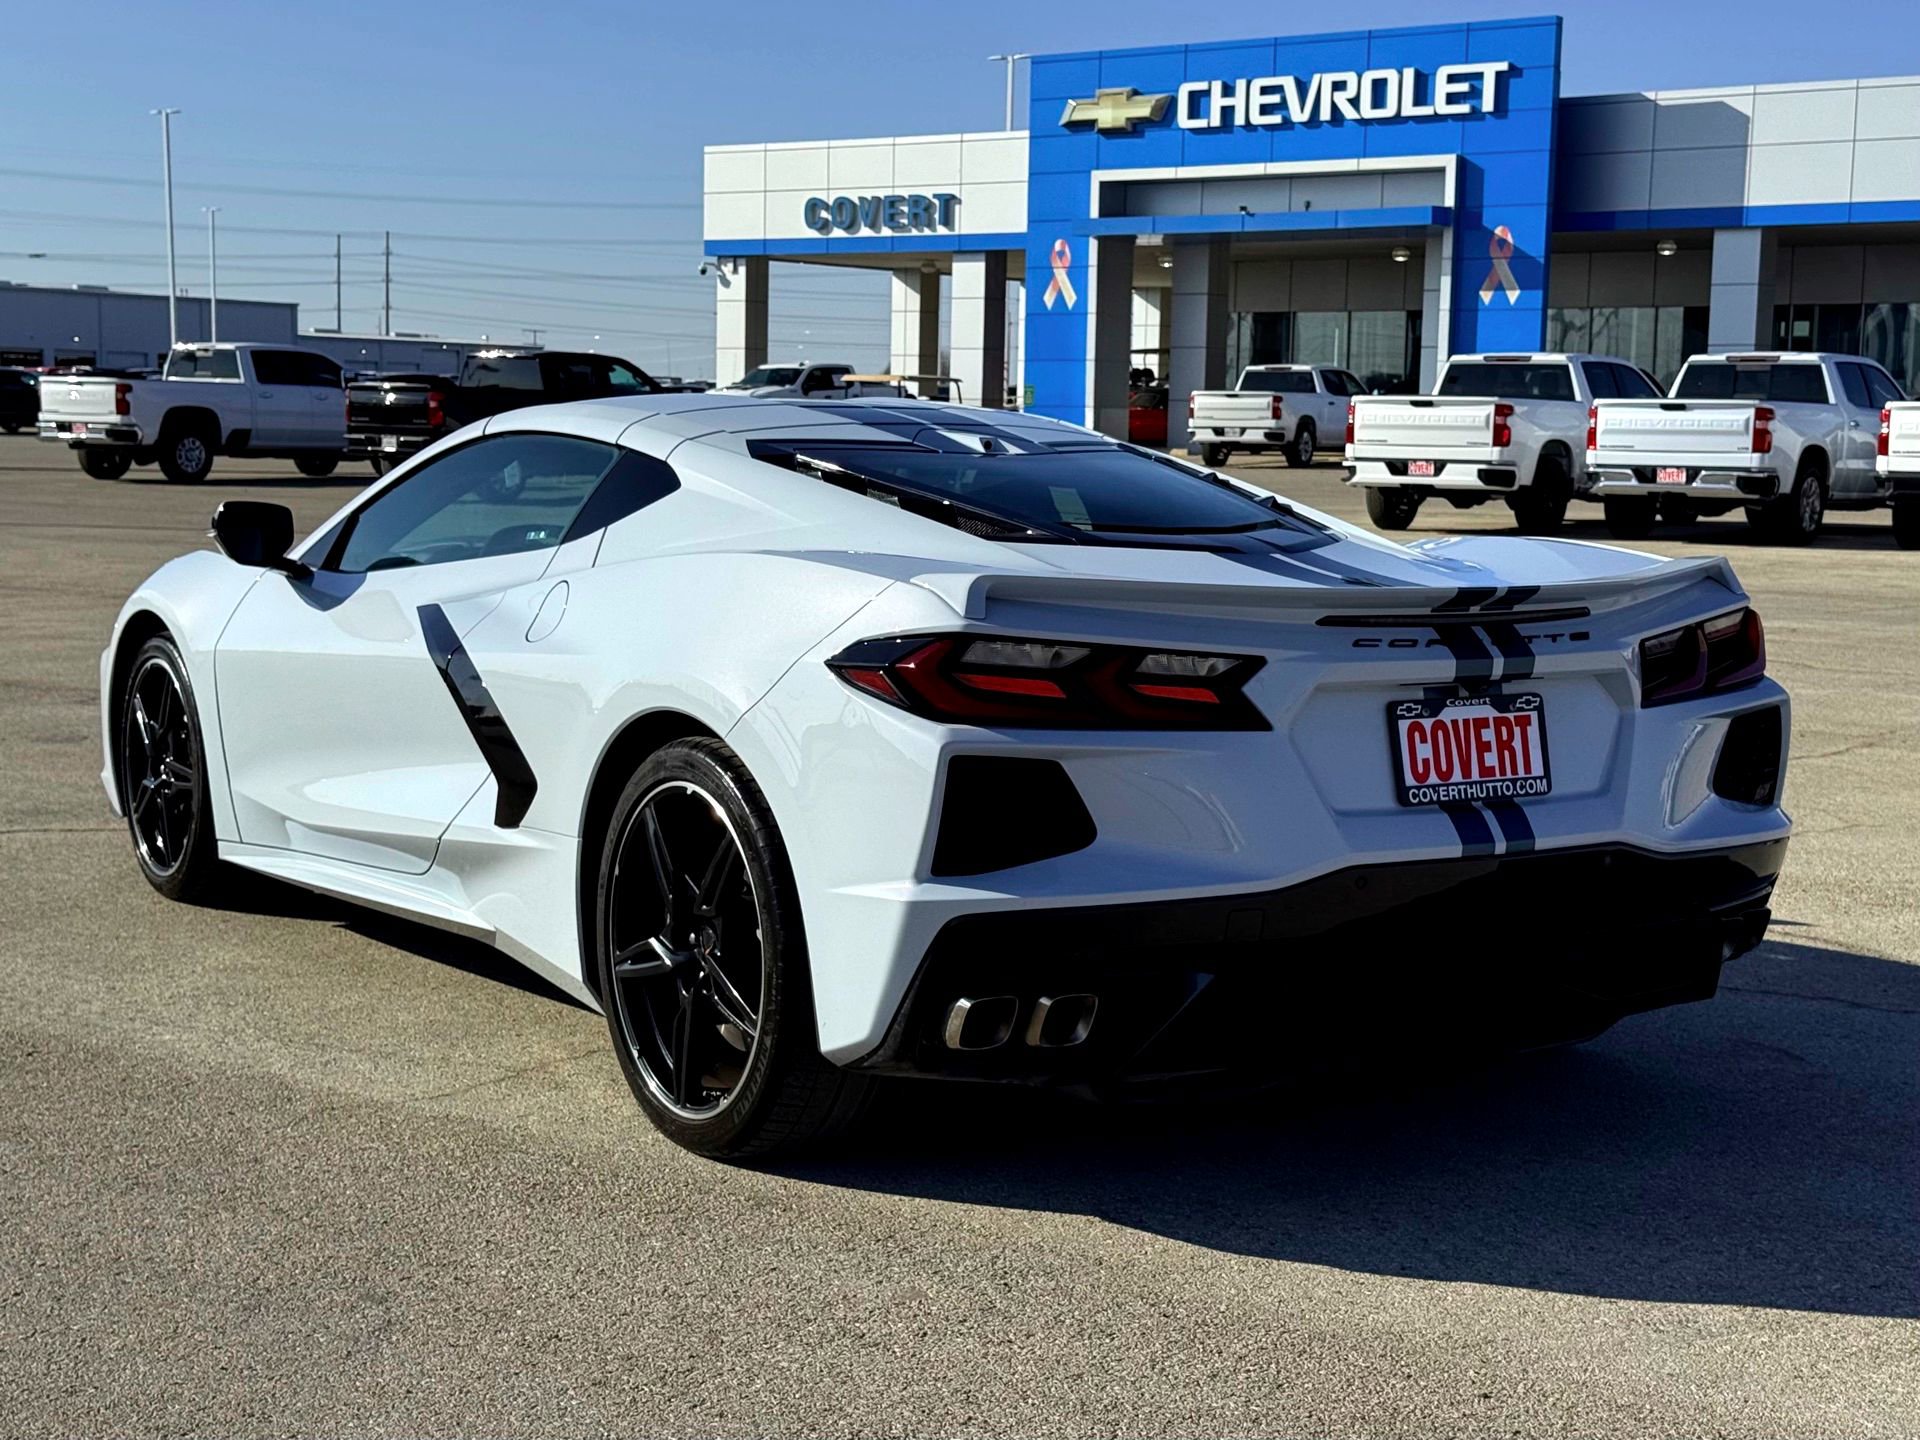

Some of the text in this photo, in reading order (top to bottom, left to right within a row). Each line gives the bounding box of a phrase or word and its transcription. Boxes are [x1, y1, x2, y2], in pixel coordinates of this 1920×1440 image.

[1177, 61, 1509, 130] CHEVROLET
[804, 193, 962, 235] COVERT
[1446, 697, 1491, 707] Covert
[1406, 714, 1533, 784] COVERT
[1409, 777, 1548, 803] COVERTHUTTO.COM
